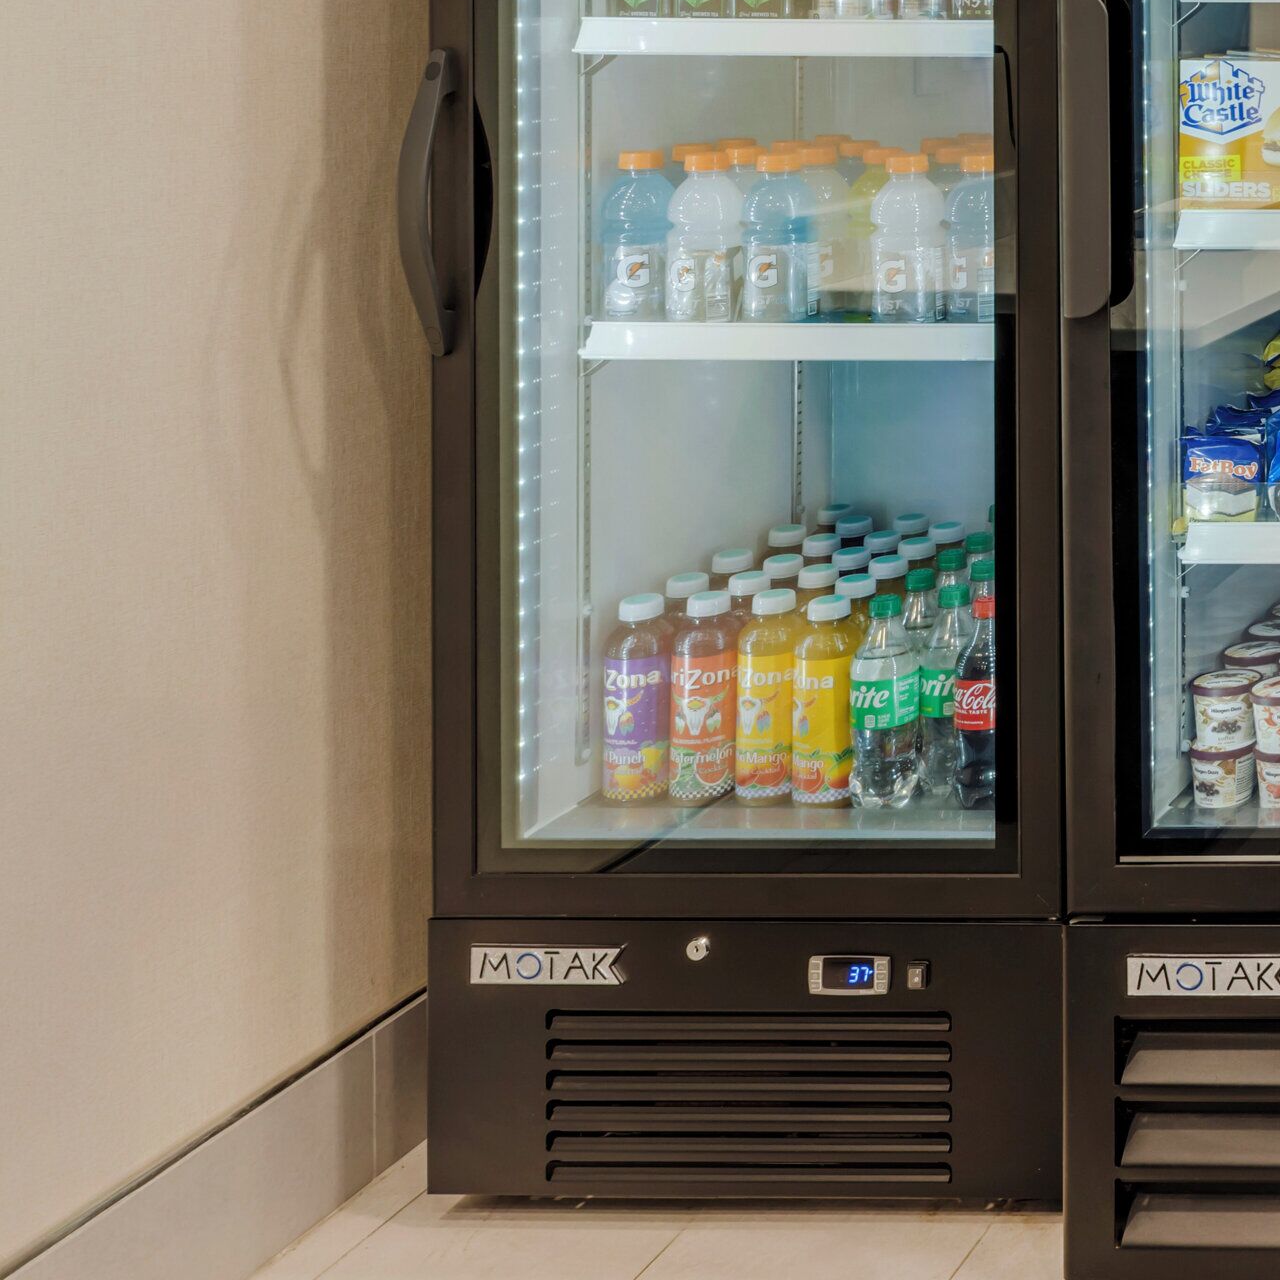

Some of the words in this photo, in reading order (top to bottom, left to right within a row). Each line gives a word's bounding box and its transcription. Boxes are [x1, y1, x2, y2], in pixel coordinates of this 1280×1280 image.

[1188, 81, 1254, 103] White
[1183, 104, 1260, 124] Castle
[1183, 159, 1235, 170] CLASSIC
[1190, 457, 1257, 479] FatBoy
[480, 951, 608, 979] MOTAK
[849, 967, 869, 982] 37
[1137, 962, 1273, 990] MOTAK
